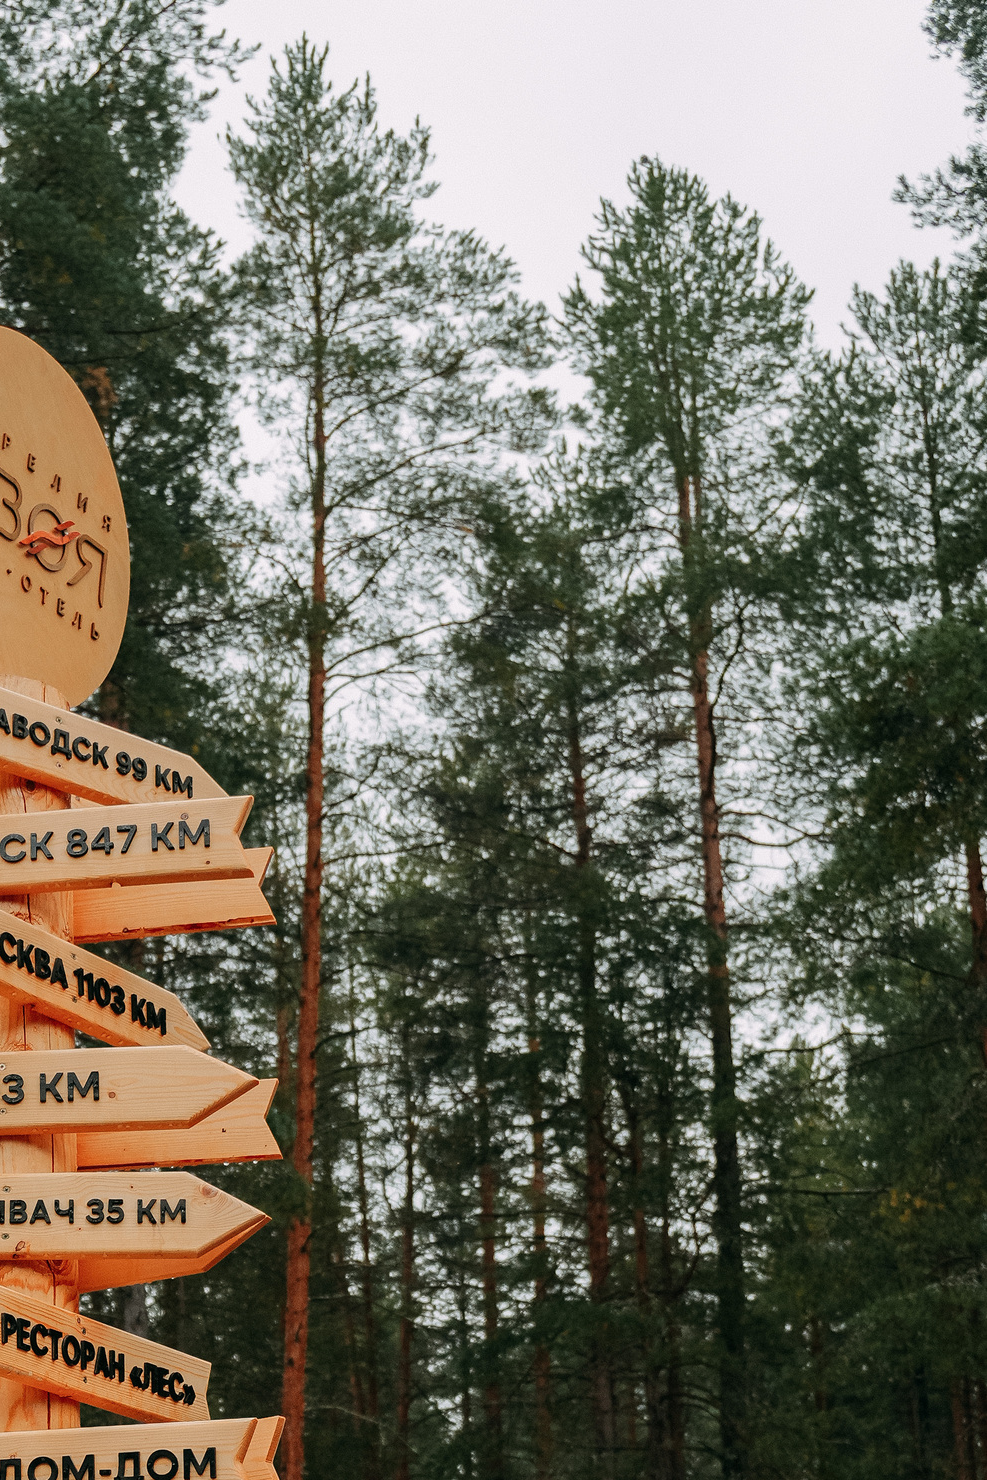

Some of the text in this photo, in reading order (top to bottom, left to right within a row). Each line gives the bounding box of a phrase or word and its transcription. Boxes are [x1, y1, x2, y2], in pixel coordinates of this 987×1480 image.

[115, 751, 148, 782] 99
[155, 764, 193, 798] КМ
[66, 824, 137, 858] 847
[150, 819, 211, 852] КМ
[74, 968, 126, 1017] 1103
[130, 995, 167, 1036] КМ
[39, 1071, 100, 1103] КМ
[86, 1199, 124, 1225] 35
[136, 1199, 186, 1225] КМ
[1, 1313, 196, 1406] РЕСТОРАН «ЛЕС»
